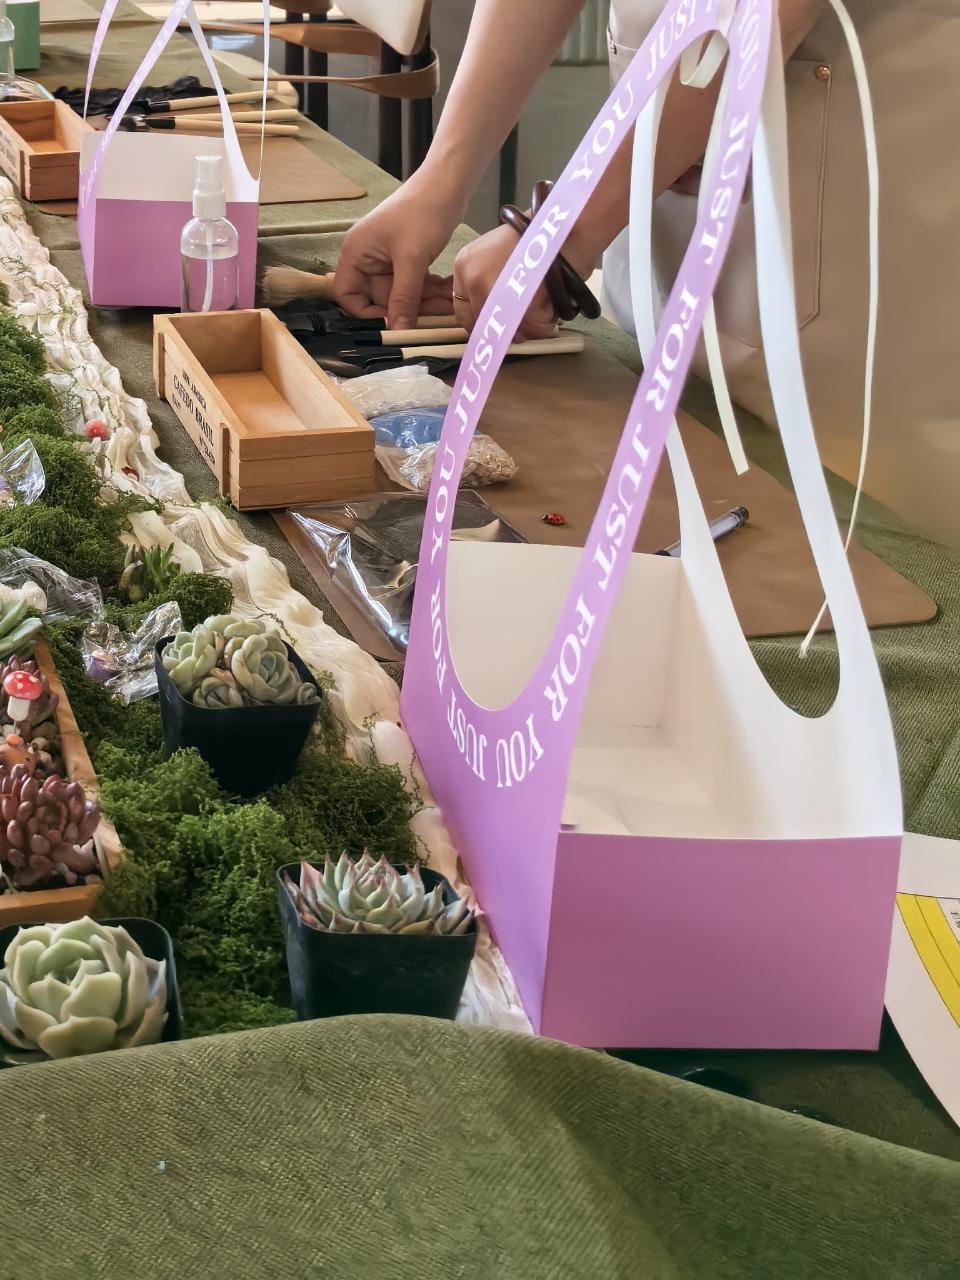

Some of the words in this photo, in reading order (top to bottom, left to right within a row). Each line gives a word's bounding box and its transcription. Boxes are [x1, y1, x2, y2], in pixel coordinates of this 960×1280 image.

[570, 81, 635, 185] YOU
[700, 111, 750, 267] JUST
[506, 204, 571, 300] FOR
[448, 306, 503, 435] JUST
[644, 281, 700, 412] FOR
[431, 445, 458, 565] YOU
[591, 423, 651, 591] JUST
[430, 578, 448, 695] FOR
[543, 593, 596, 722] FOR
[447, 688, 488, 782] JUST
[496, 713, 544, 788] YOU
